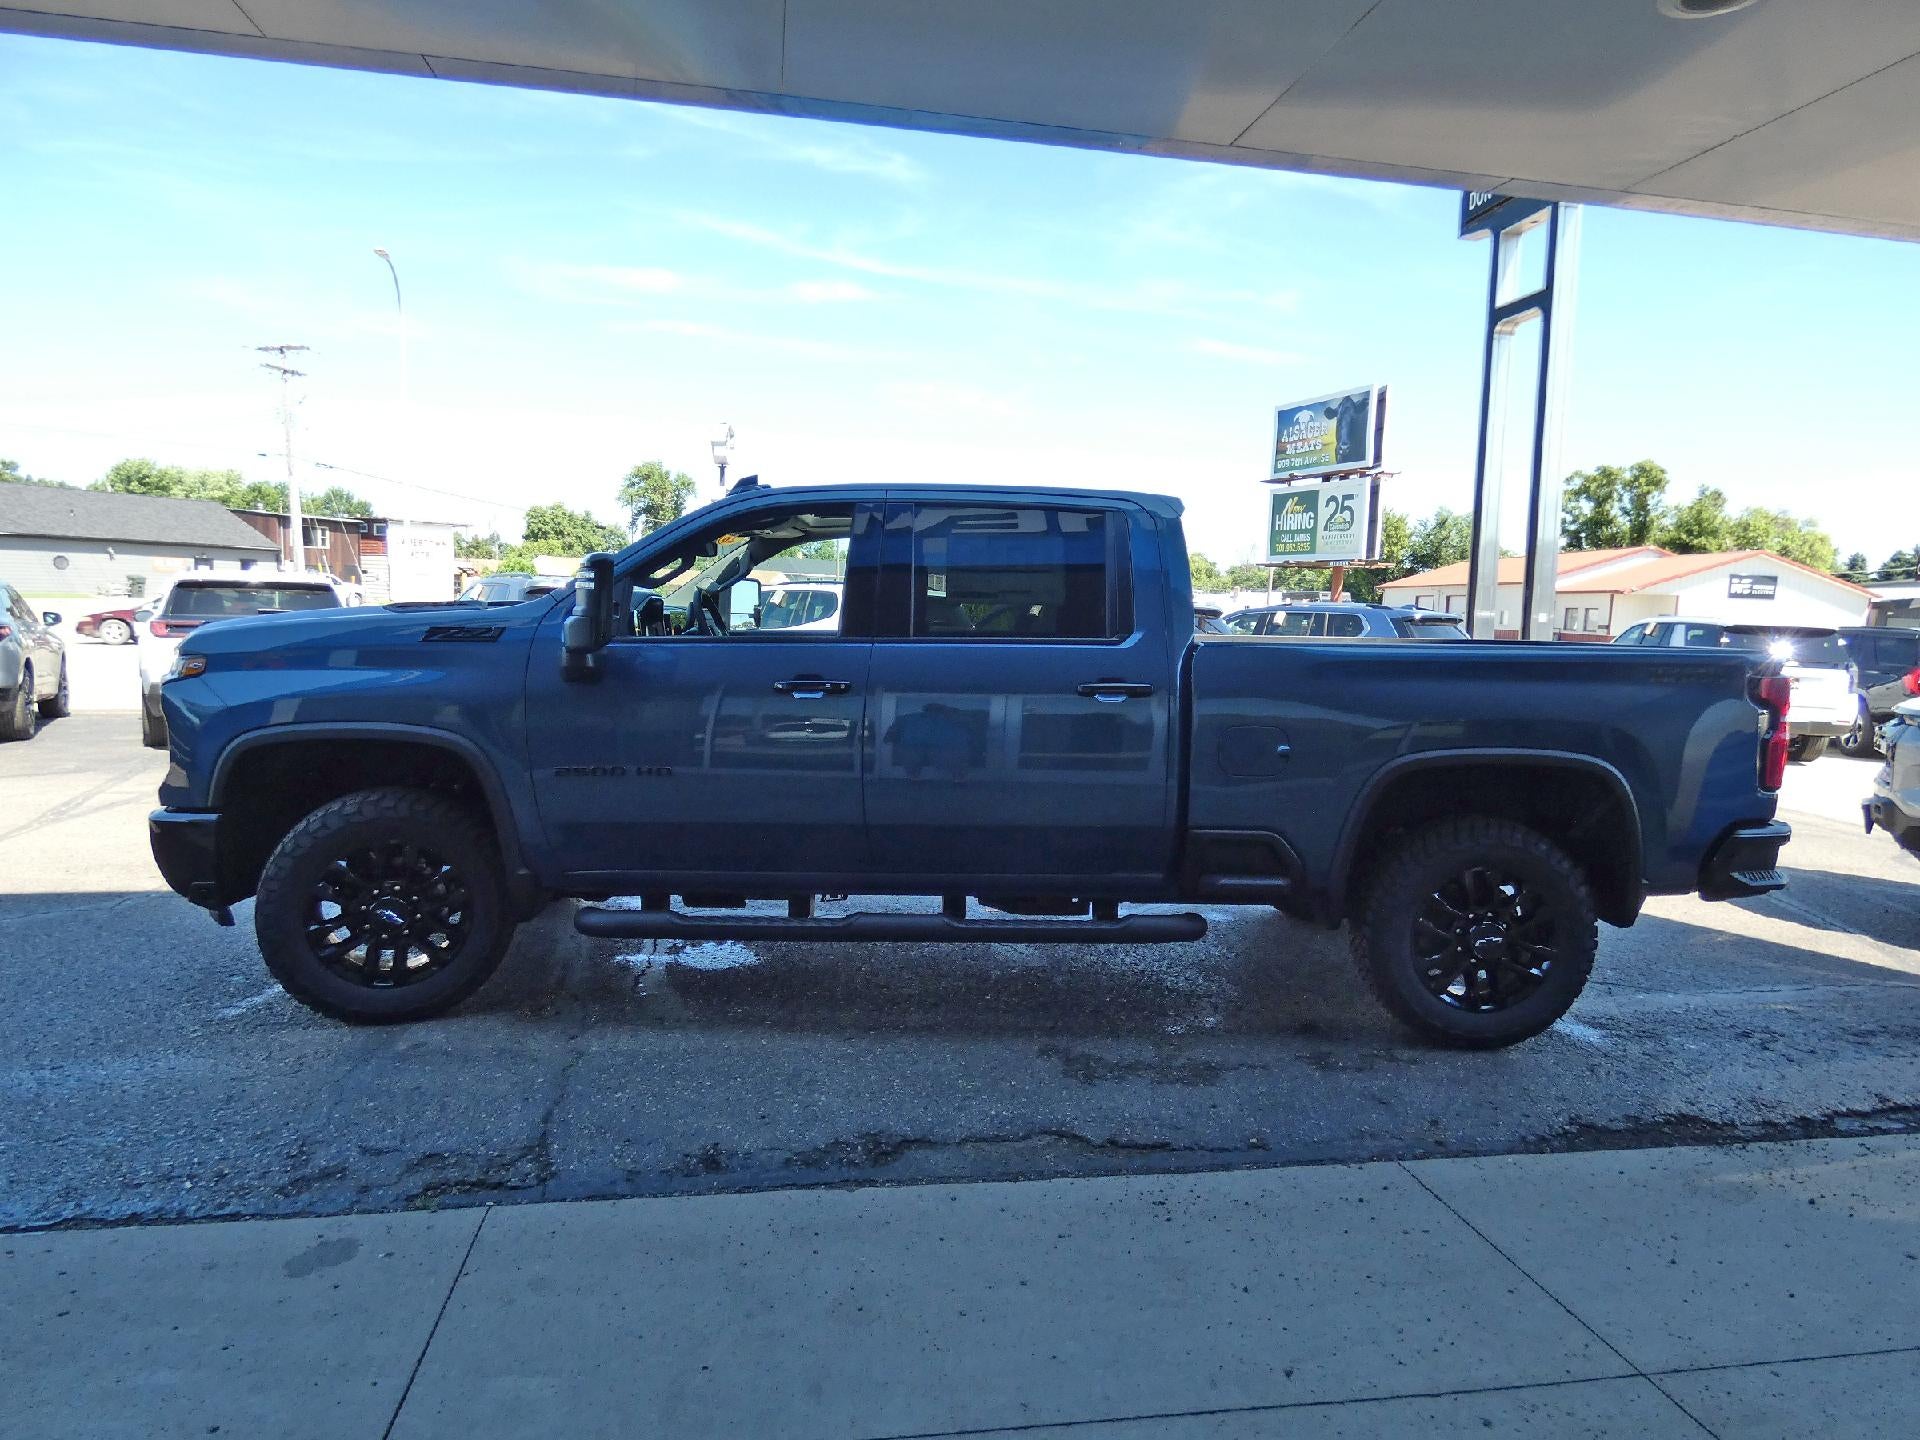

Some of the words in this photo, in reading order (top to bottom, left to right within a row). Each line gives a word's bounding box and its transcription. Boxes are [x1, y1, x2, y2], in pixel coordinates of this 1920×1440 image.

[1282, 422, 1328, 442] ALSAGER
[1286, 439, 1322, 455] MEATS
[1275, 511, 1315, 531] HIRING
[1280, 533, 1292, 543] CALL
[1293, 533, 1311, 542] JAMES
[636, 766, 673, 777] HD
